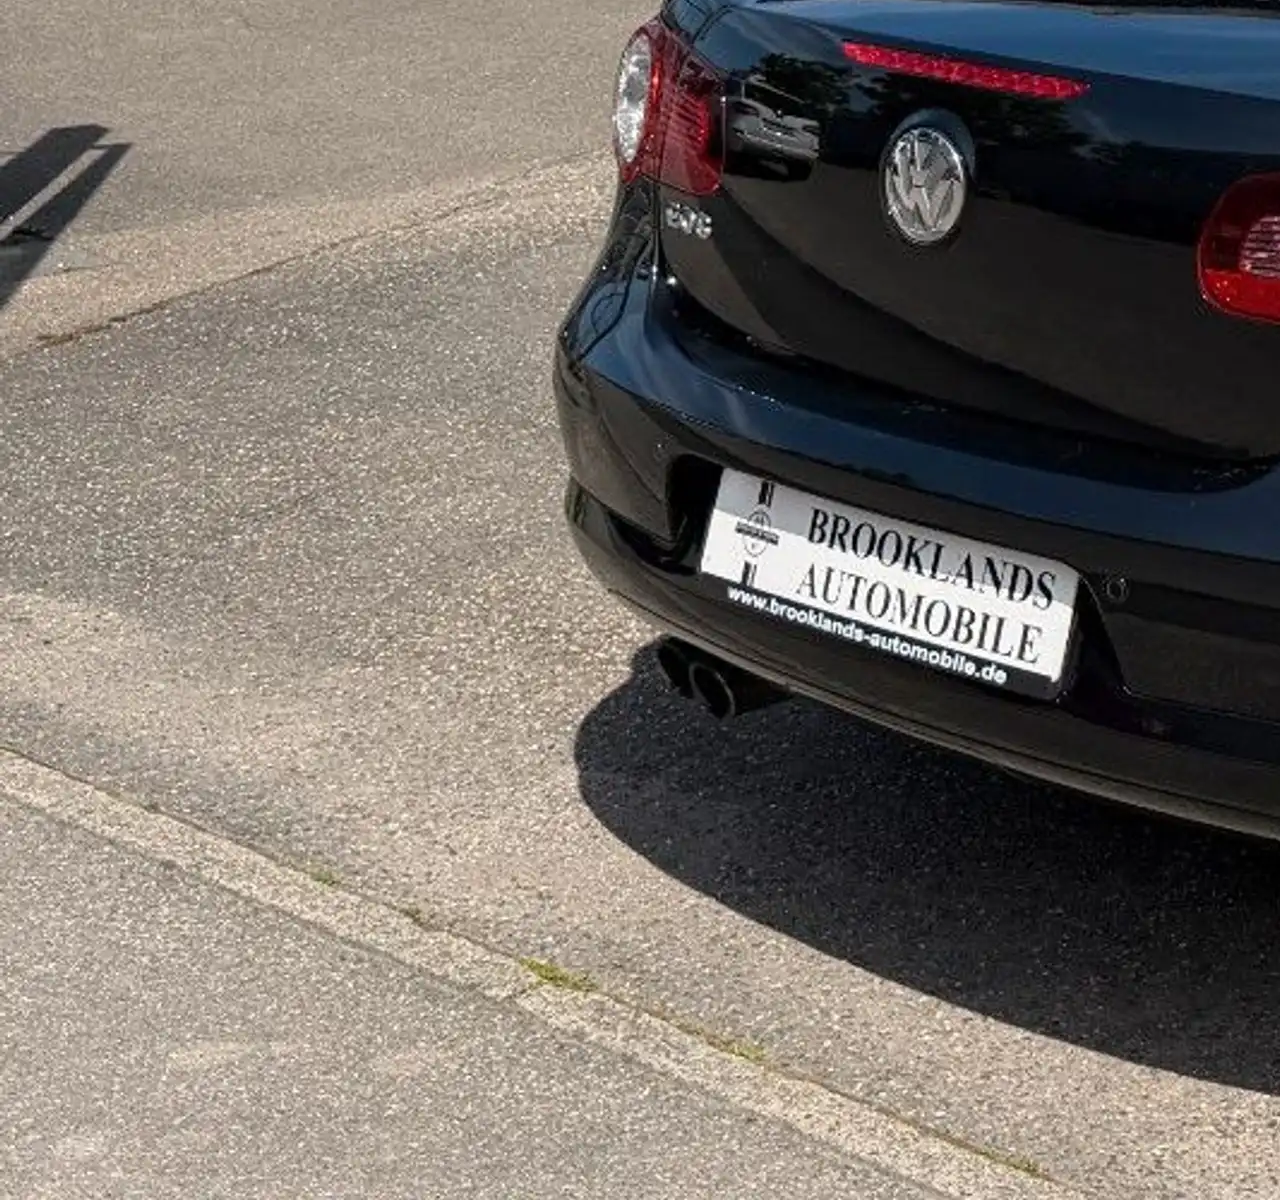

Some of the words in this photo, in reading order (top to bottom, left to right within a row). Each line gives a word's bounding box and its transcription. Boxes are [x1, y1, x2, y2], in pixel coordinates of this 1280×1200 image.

[807, 505, 1057, 611] BROOKLANDS
[727, 584, 1008, 686] www.brooklands-automobile.de
[796, 562, 1043, 665] AUTOMOBILE
